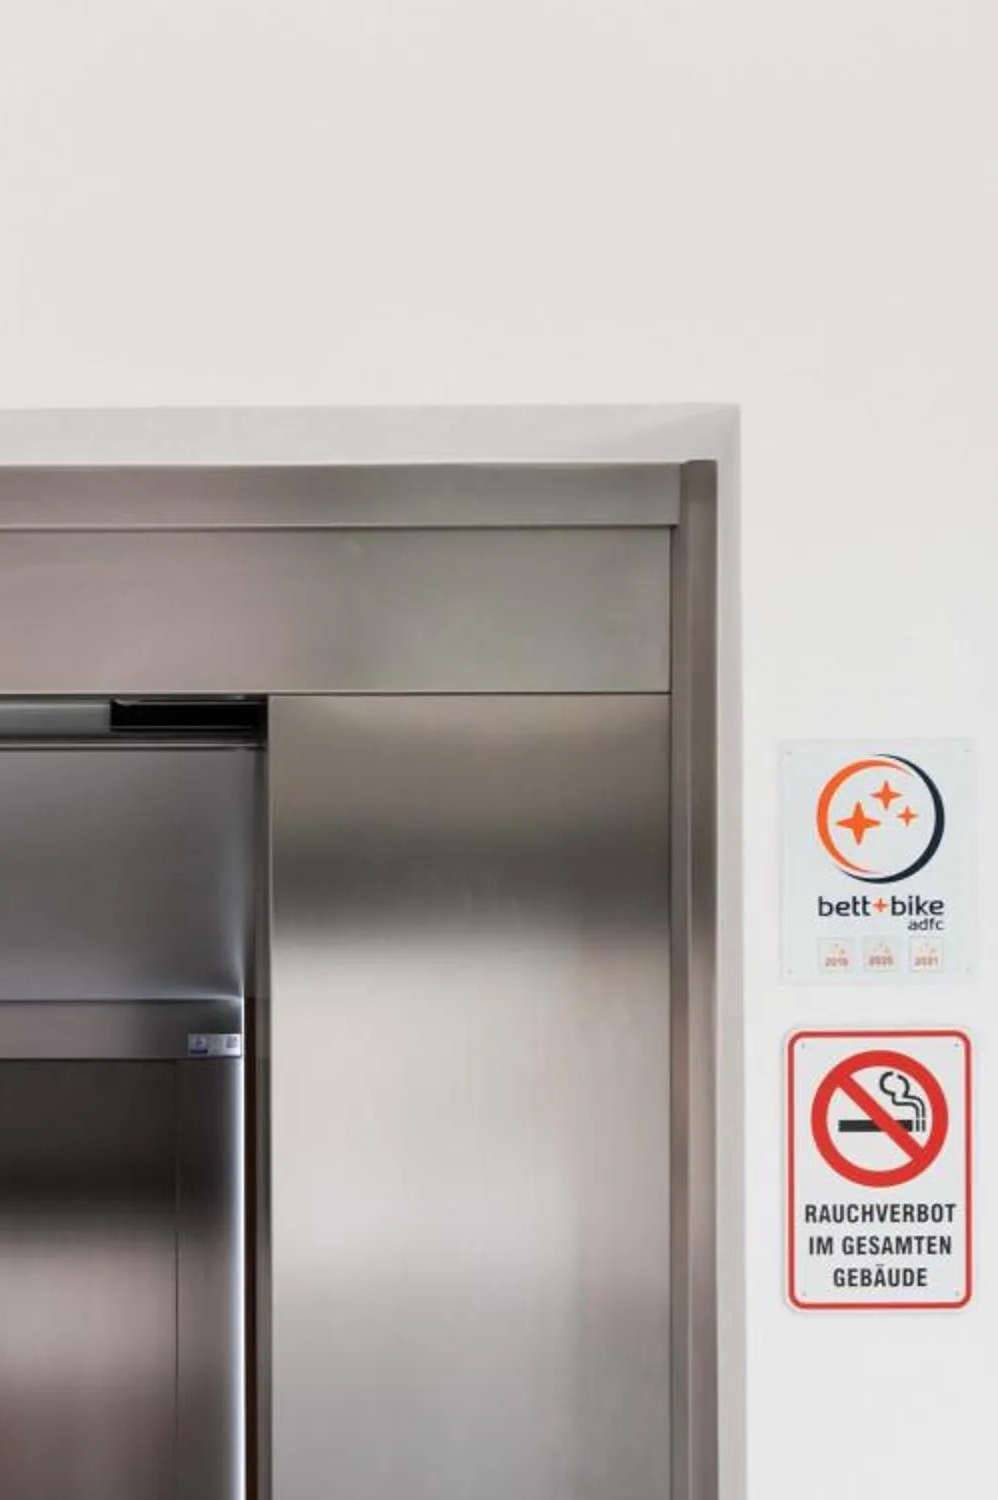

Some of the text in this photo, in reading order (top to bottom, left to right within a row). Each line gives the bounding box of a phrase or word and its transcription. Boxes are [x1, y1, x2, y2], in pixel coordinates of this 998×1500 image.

[907, 917, 944, 931] adfc
[804, 1203, 956, 1224] RAUCHVERBOT
[809, 1235, 952, 1255] IM GESAMTEN
[833, 1263, 928, 1288] GEBÄUDE
